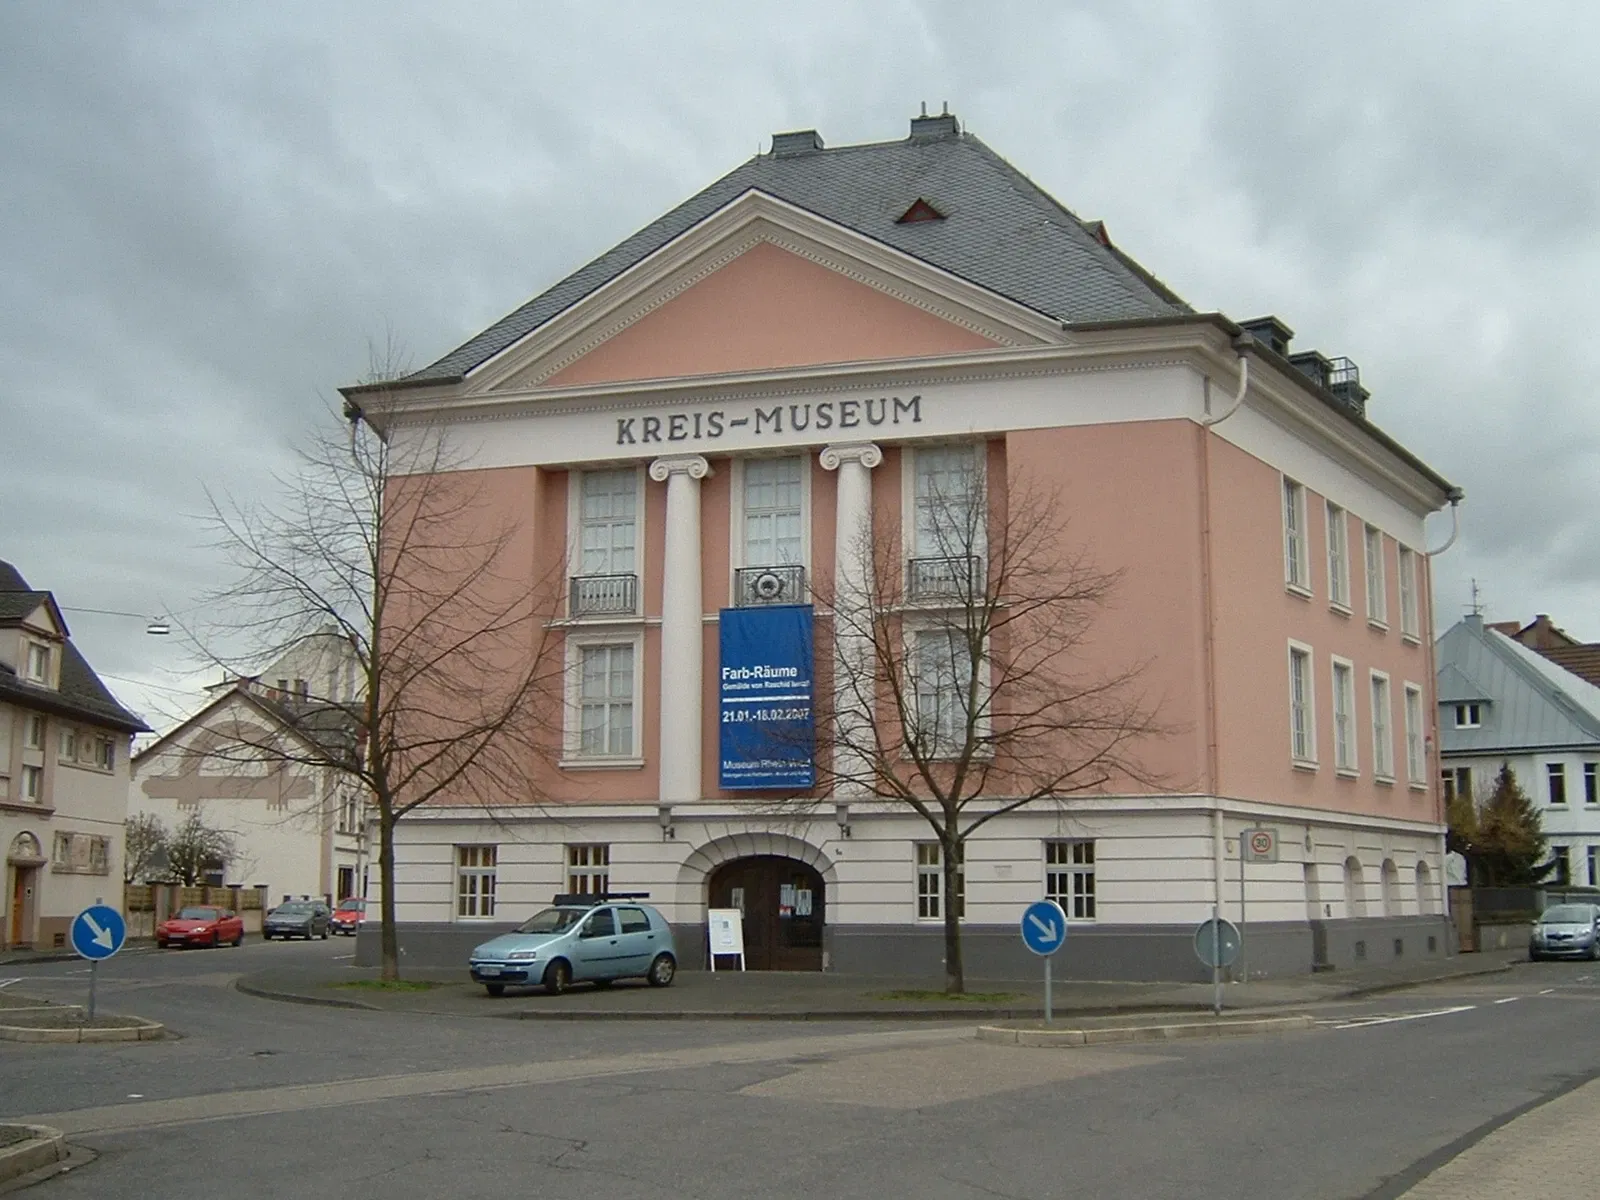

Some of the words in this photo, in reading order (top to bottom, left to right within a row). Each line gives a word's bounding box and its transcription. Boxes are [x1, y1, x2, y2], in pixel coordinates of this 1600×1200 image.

[616, 395, 922, 445] KREIS-MUSEUM
[722, 665, 798, 680] Farb-Räume
[1256, 838, 1268, 848] 30
